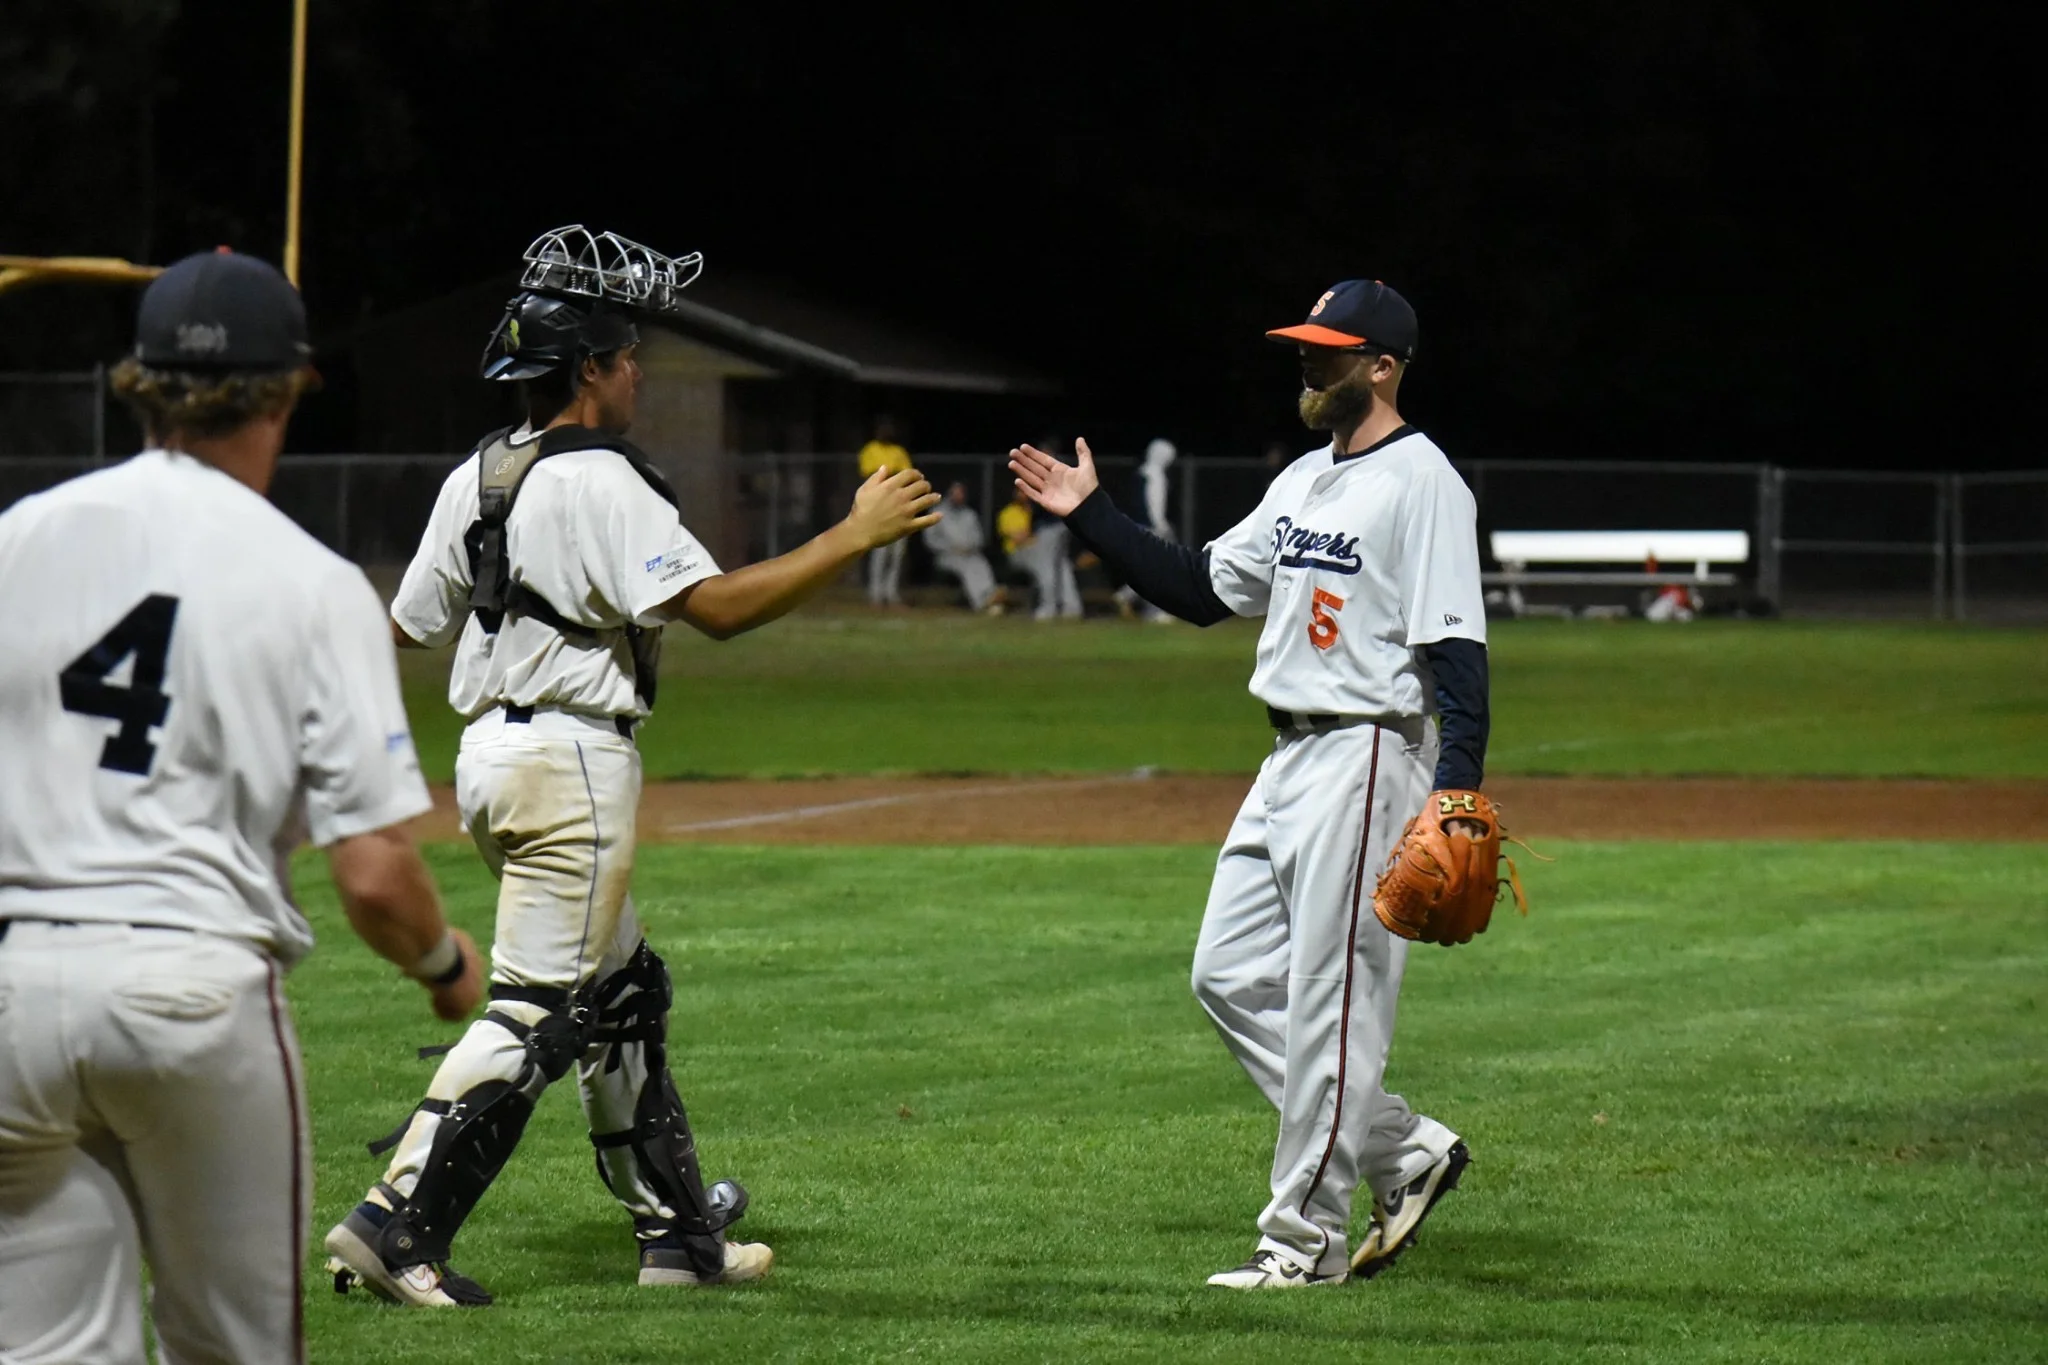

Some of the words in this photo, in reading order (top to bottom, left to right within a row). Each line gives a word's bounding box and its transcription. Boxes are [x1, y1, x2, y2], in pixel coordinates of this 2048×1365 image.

[1310, 291, 1335, 316] S
[1307, 586, 1345, 651] 5
[59, 593, 180, 776] 4
